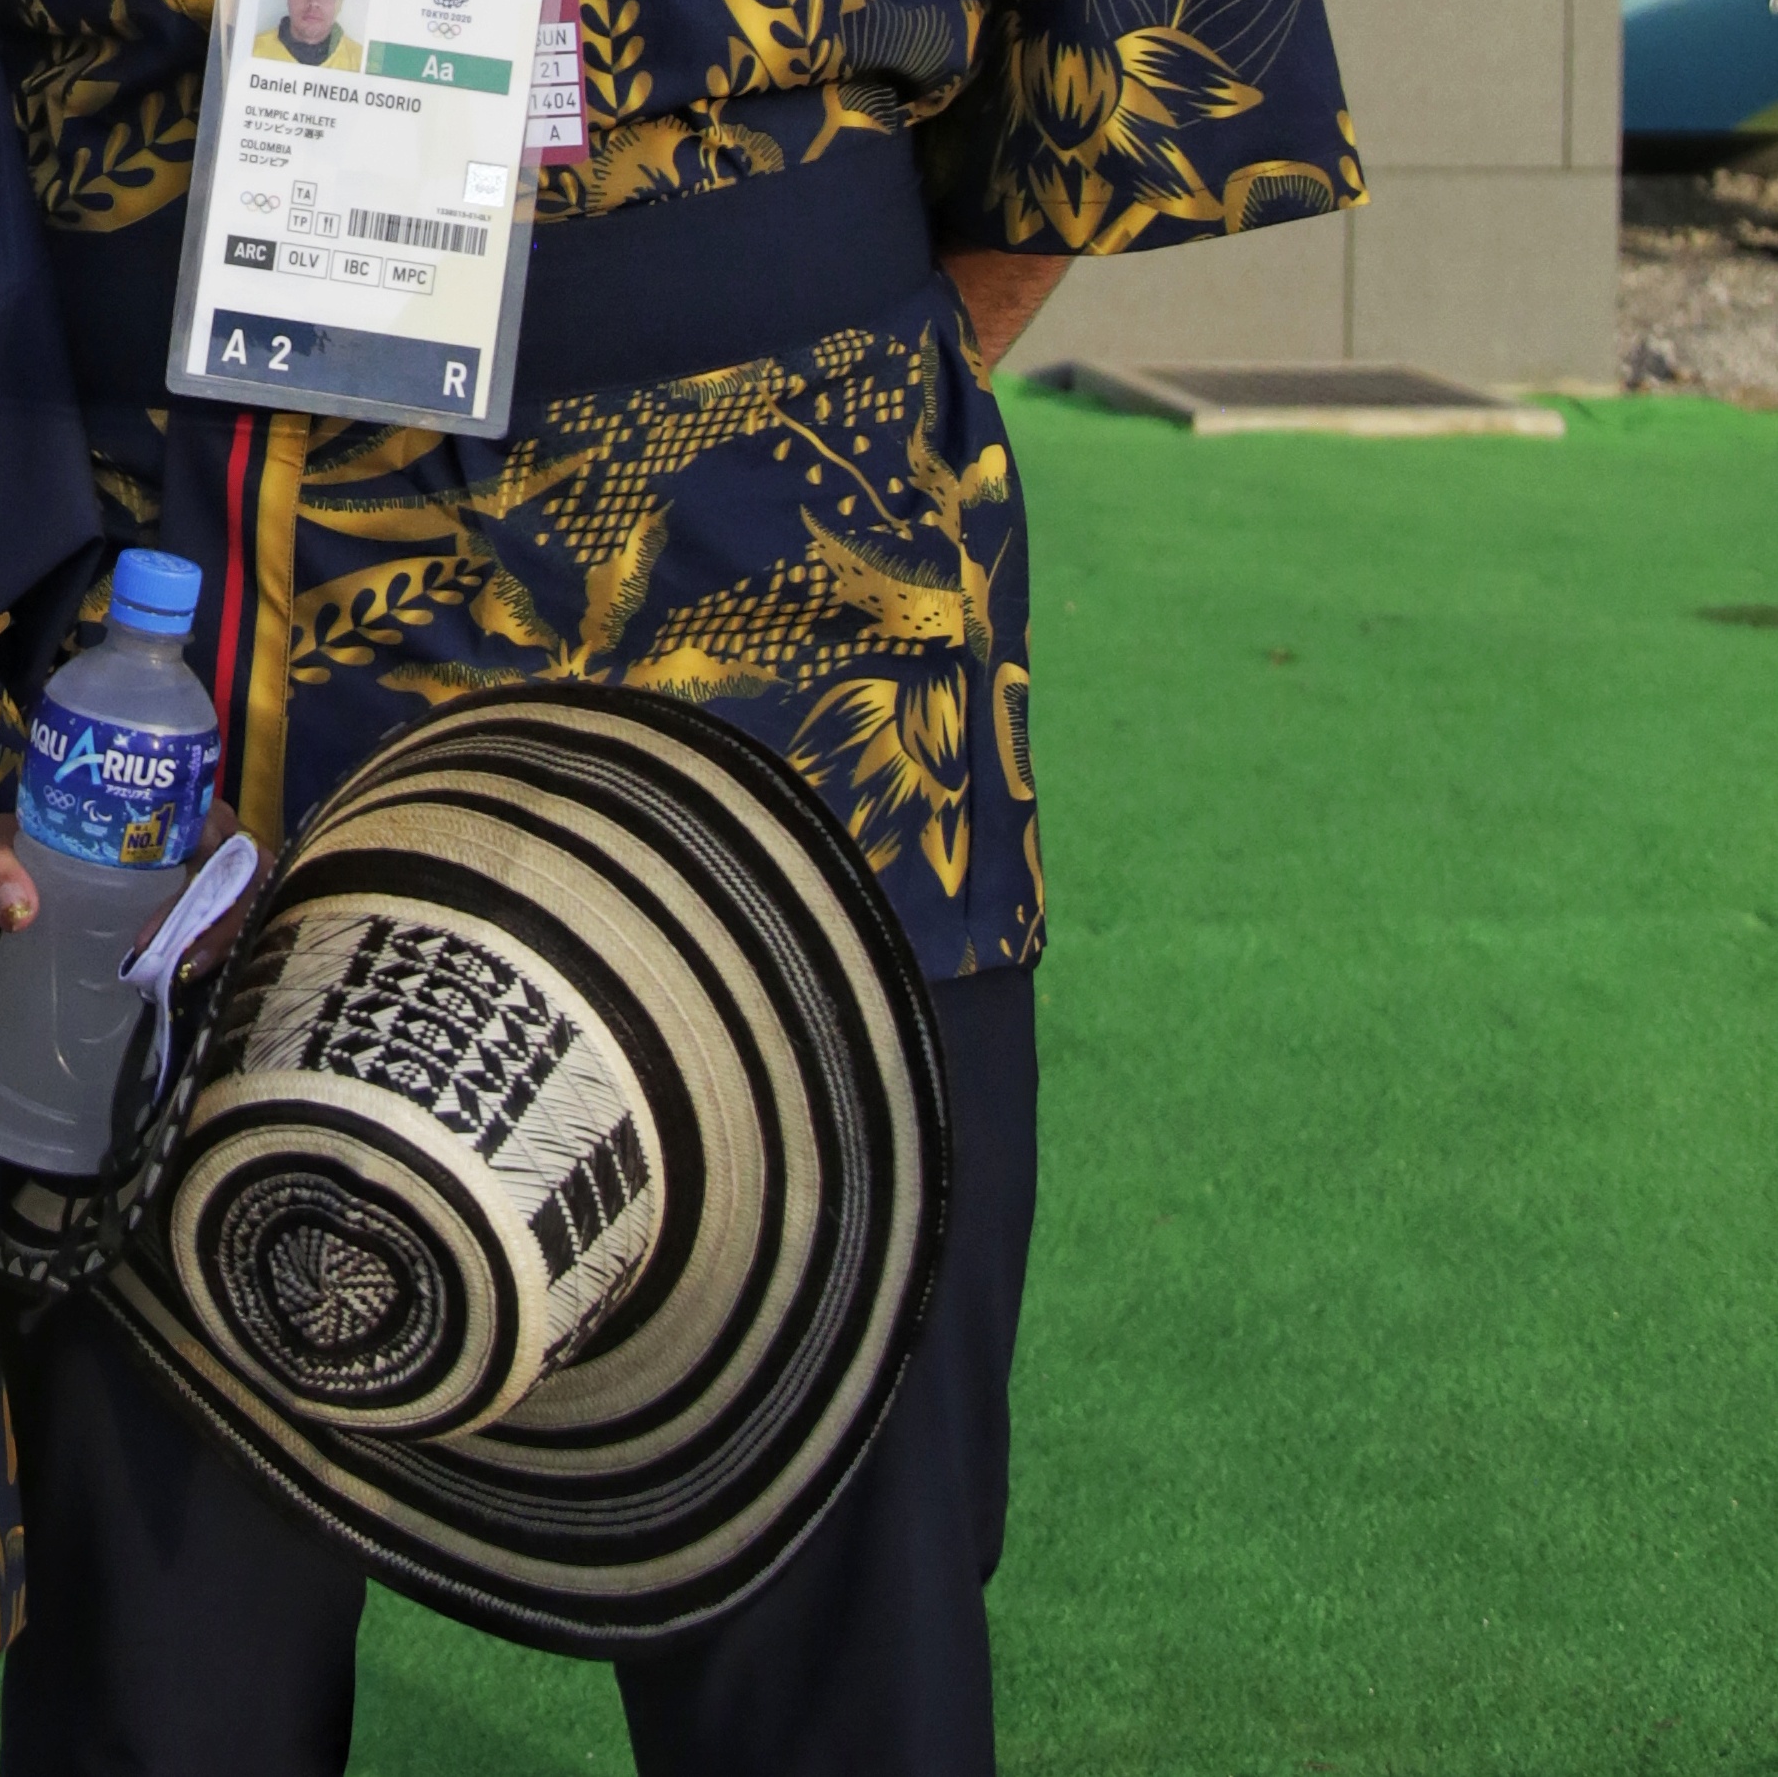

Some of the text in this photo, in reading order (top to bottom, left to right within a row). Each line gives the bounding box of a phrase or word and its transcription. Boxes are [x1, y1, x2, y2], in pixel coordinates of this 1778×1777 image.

[421, 8, 472, 23] TOKYO 2020
[421, 54, 455, 82] Aa
[539, 61, 560, 78] 21
[249, 73, 422, 113] Daniel PINEDA OSORIO
[530, 91, 577, 111] 1404
[245, 105, 337, 128] OLYMPIC ATHLETE
[549, 124, 562, 142] A
[240, 138, 293, 156] COLOMBIA
[296, 186, 312, 201] TA
[292, 215, 308, 228] TP
[233, 241, 268, 262] ARC
[288, 250, 321, 269] OLV
[343, 258, 371, 277] IBC
[391, 266, 428, 286] MPC
[221, 328, 293, 372] A 2
[442, 360, 468, 399] R
[30, 717, 177, 789] AQUARIUS
